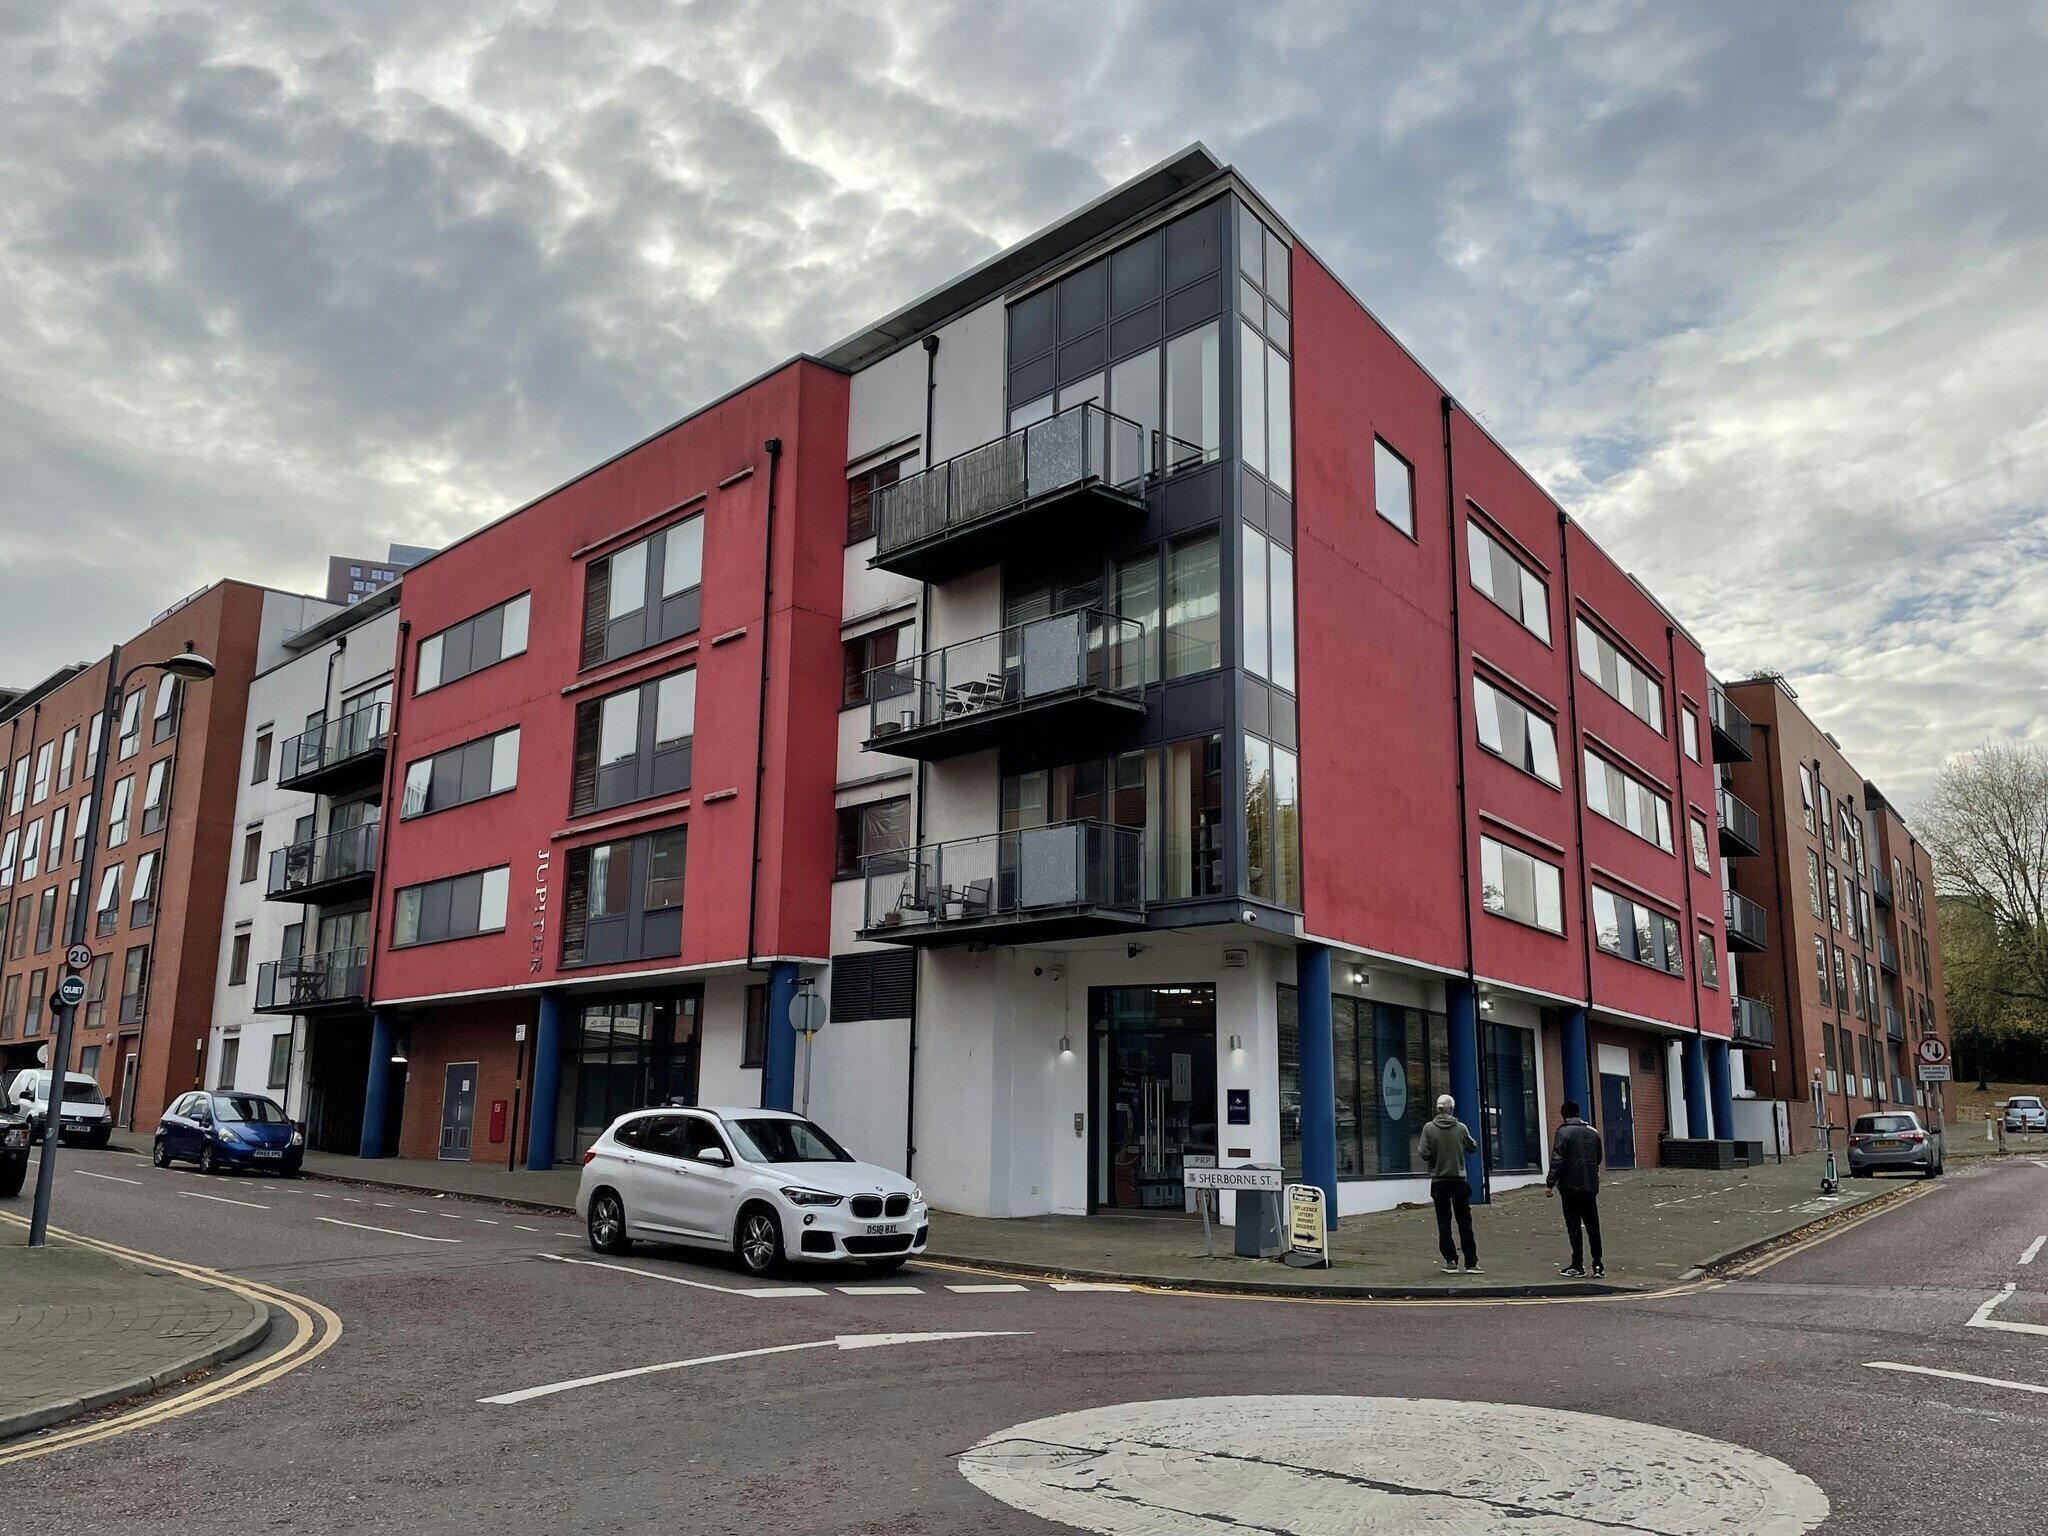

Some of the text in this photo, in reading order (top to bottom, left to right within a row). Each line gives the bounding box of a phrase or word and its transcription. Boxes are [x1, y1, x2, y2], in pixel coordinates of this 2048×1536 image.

[530, 849, 550, 976] JUPITER
[70, 951, 89, 963] 20
[63, 986, 83, 994] QUIET
[1195, 1156, 1211, 1164] PRP
[1199, 1173, 1257, 1185] SHERBORNE
